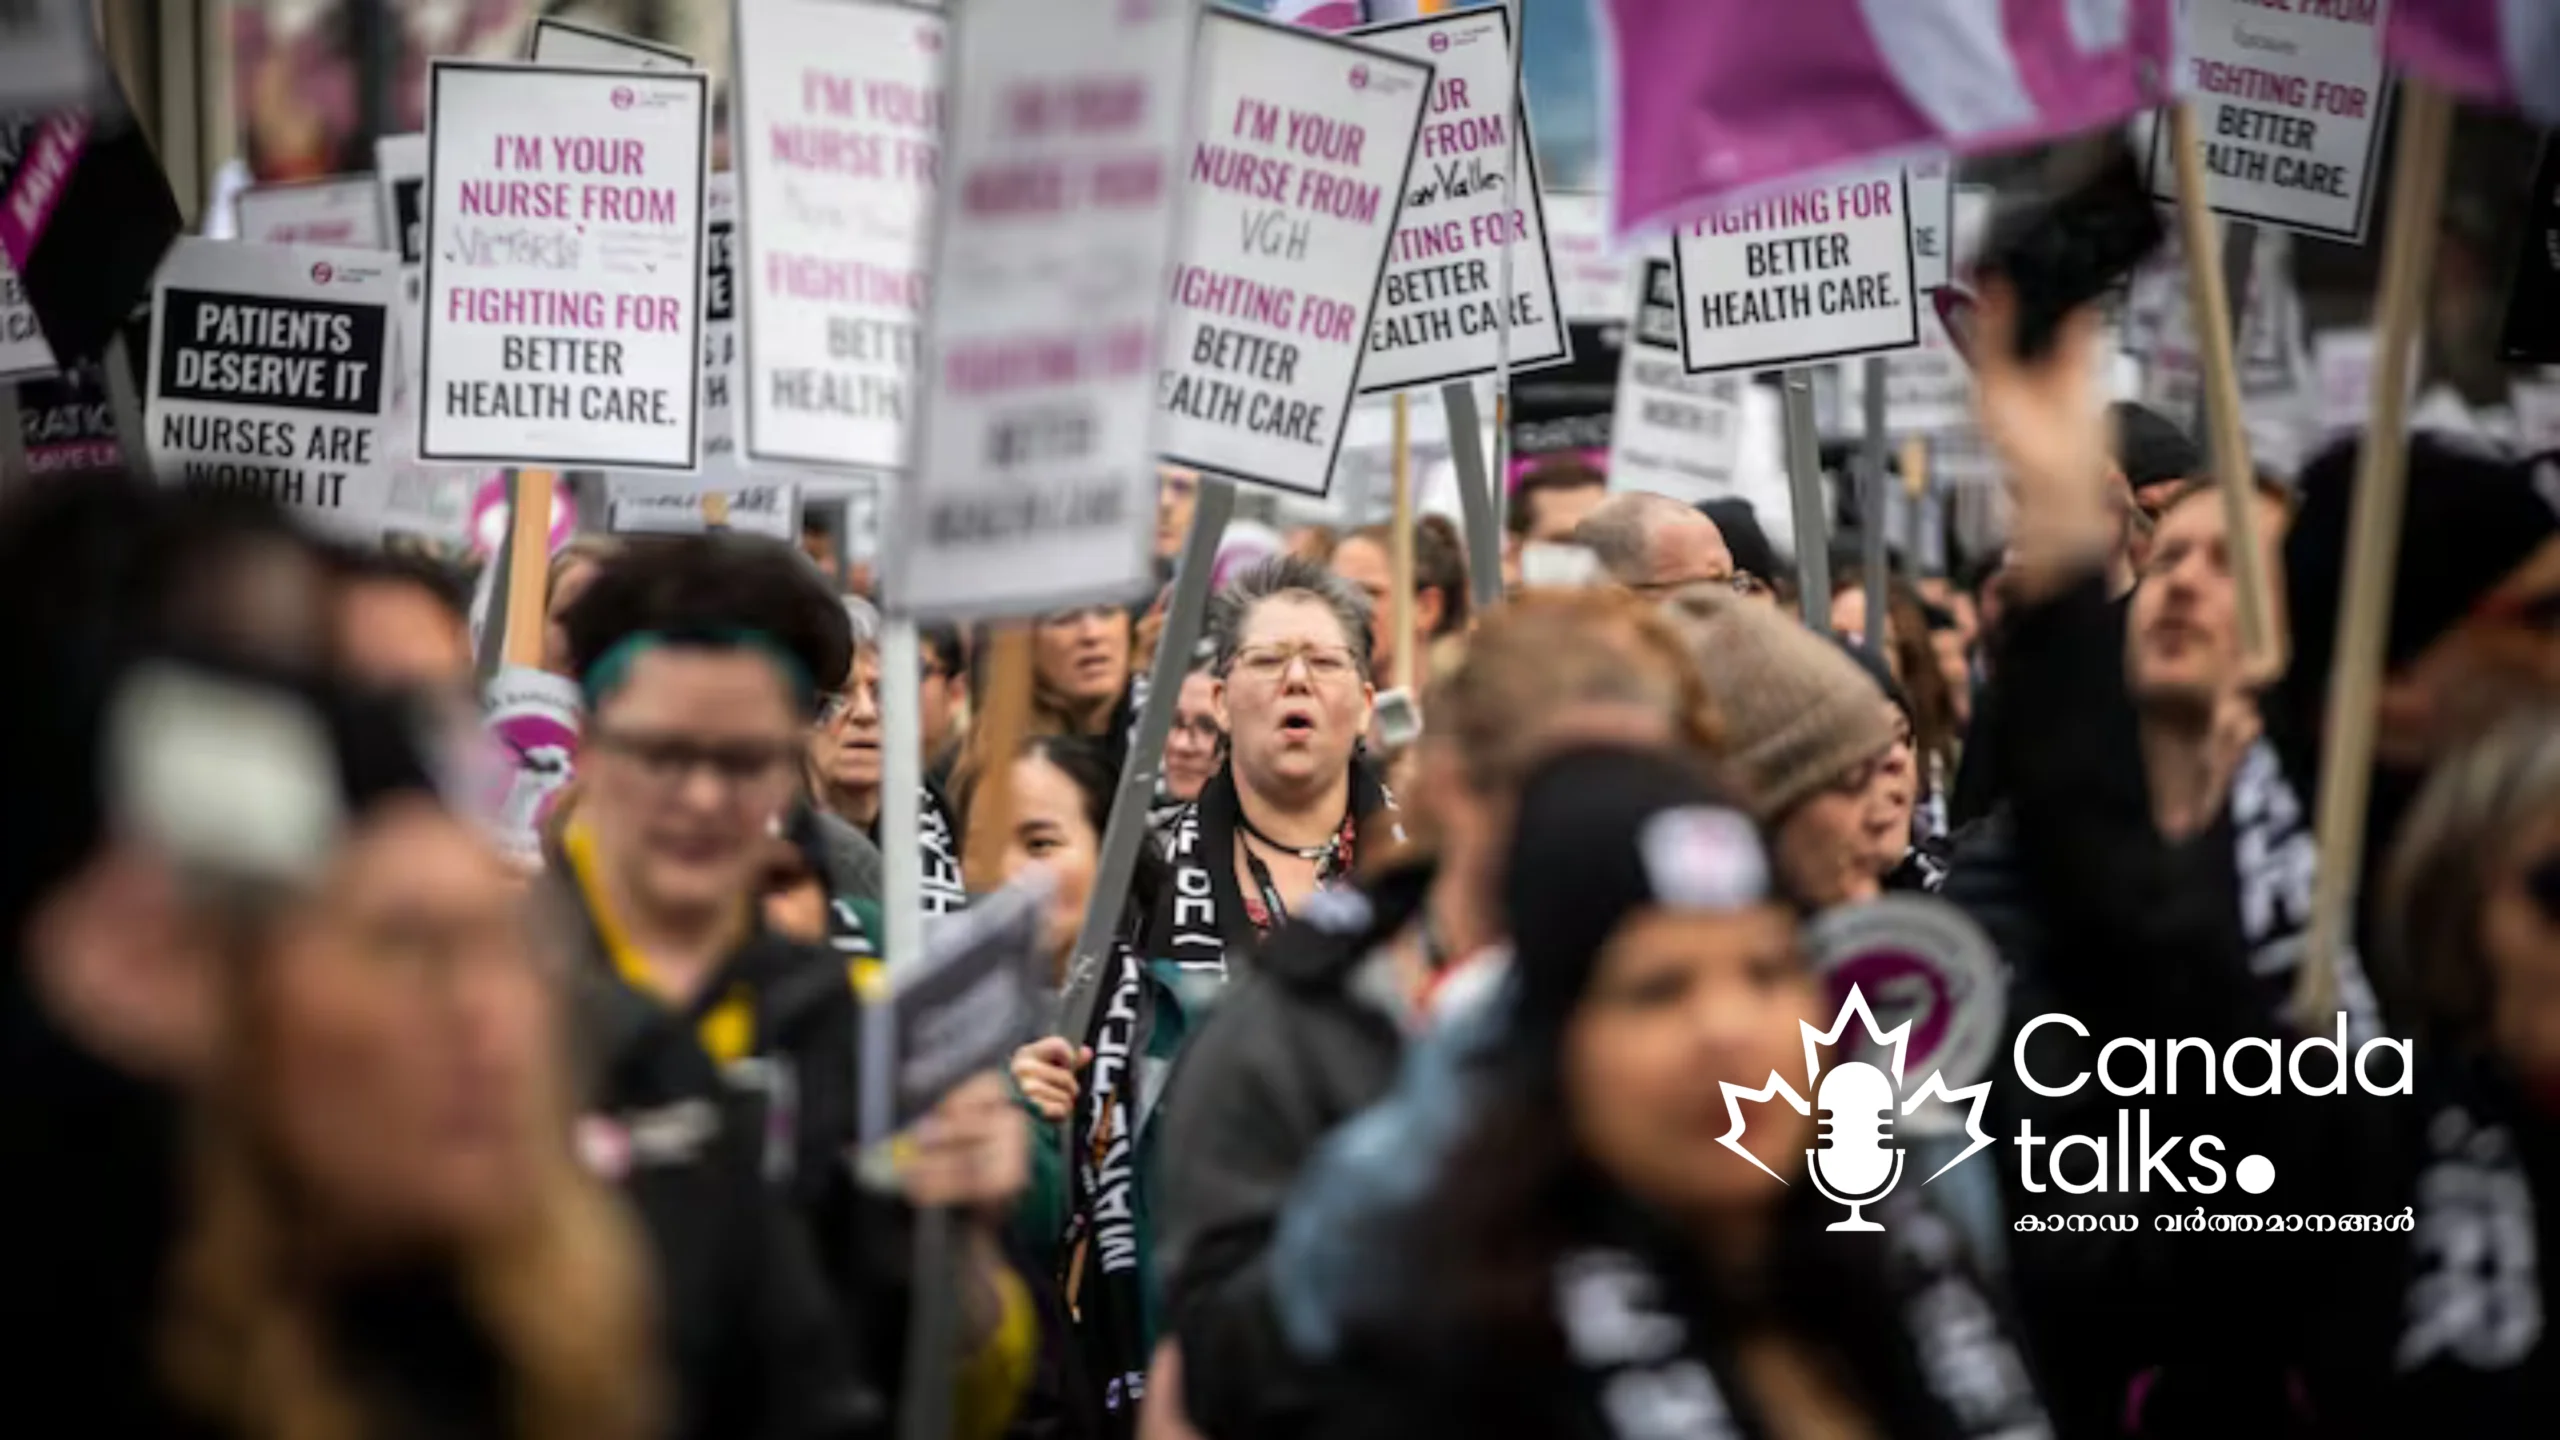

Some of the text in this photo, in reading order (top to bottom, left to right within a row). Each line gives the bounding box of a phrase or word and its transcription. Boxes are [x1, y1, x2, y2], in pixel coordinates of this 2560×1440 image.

[1430, 77, 1471, 115] UR
[2311, 80, 2368, 119] FOR
[1233, 95, 1366, 167] I'M YOUR
[1424, 113, 1507, 159] FROM
[2216, 103, 2318, 151] BETTER
[495, 134, 645, 175] I'M YOUR
[2272, 156, 2350, 199] CARE.
[1190, 141, 1294, 205] NURSE
[1296, 167, 1382, 226] FROM
[1432, 156, 1504, 201] Valle
[1837, 180, 1893, 222] FOR
[459, 179, 676, 225] NURSE FROM
[1240, 207, 1311, 261] VGH
[1391, 220, 1466, 263] TING
[1745, 232, 1851, 279] BETTER
[1172, 263, 1358, 344] IGHTING FOR
[1386, 259, 1489, 307] BETTER
[1702, 272, 1902, 329] HEALTH CARE.
[195, 302, 353, 355] PATIENTS
[447, 287, 680, 332] FIGHTING FOR
[1371, 308, 1453, 352] EALTH
[175, 347, 369, 401] DESERVE IT
[502, 334, 623, 376] BETTER
[1191, 323, 1301, 385] BETTER
[445, 380, 571, 419] HEALTH
[580, 386, 676, 426] CARE.
[1157, 369, 1325, 448] EALTH CARE.
[163, 413, 295, 458] NURSES
[305, 424, 372, 465] ARE
[317, 472, 346, 508] IT
